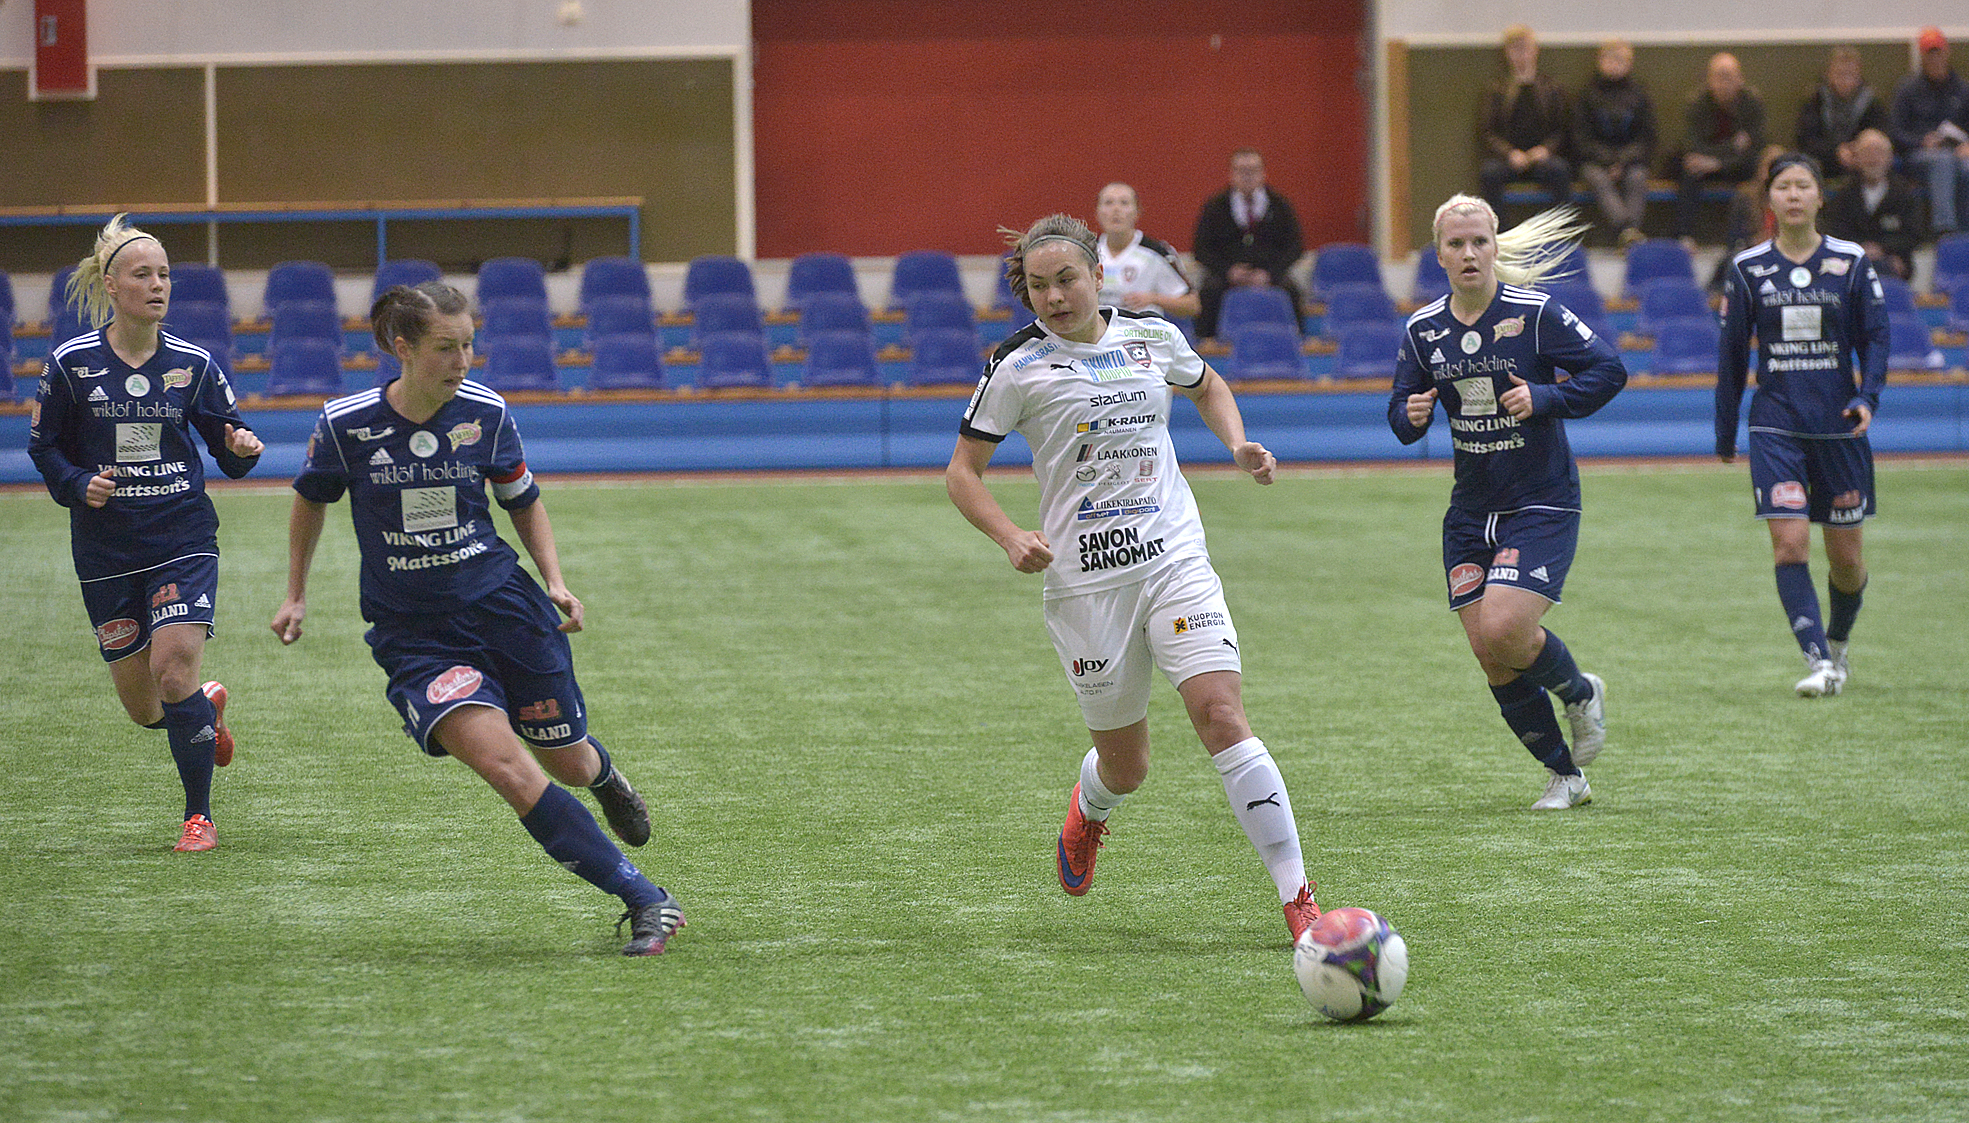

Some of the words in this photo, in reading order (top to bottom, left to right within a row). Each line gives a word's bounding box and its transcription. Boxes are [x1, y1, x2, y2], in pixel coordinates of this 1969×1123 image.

[1124, 329, 1164, 340] ORTHOLINE
[1089, 350, 1126, 370] KUNTO
[1468, 355, 1517, 374] holding
[1097, 366, 1132, 381] KUOPIO
[1090, 391, 1147, 407] stadium
[92, 401, 133, 417] wiklöf
[136, 401, 183, 423] holding
[1487, 415, 1521, 431] LINE
[1097, 447, 1157, 460] LAAKKONEN
[153, 461, 187, 476] LINE
[370, 463, 418, 484] wiklöf
[422, 460, 479, 483] holding
[382, 531, 442, 547] VIKING
[445, 520, 476, 544] LINE
[1079, 527, 1139, 553] SAVON
[1080, 538, 1165, 572] SANOMAT
[1188, 612, 1224, 623] KUOPION
[1189, 619, 1225, 630] ENERGIA
